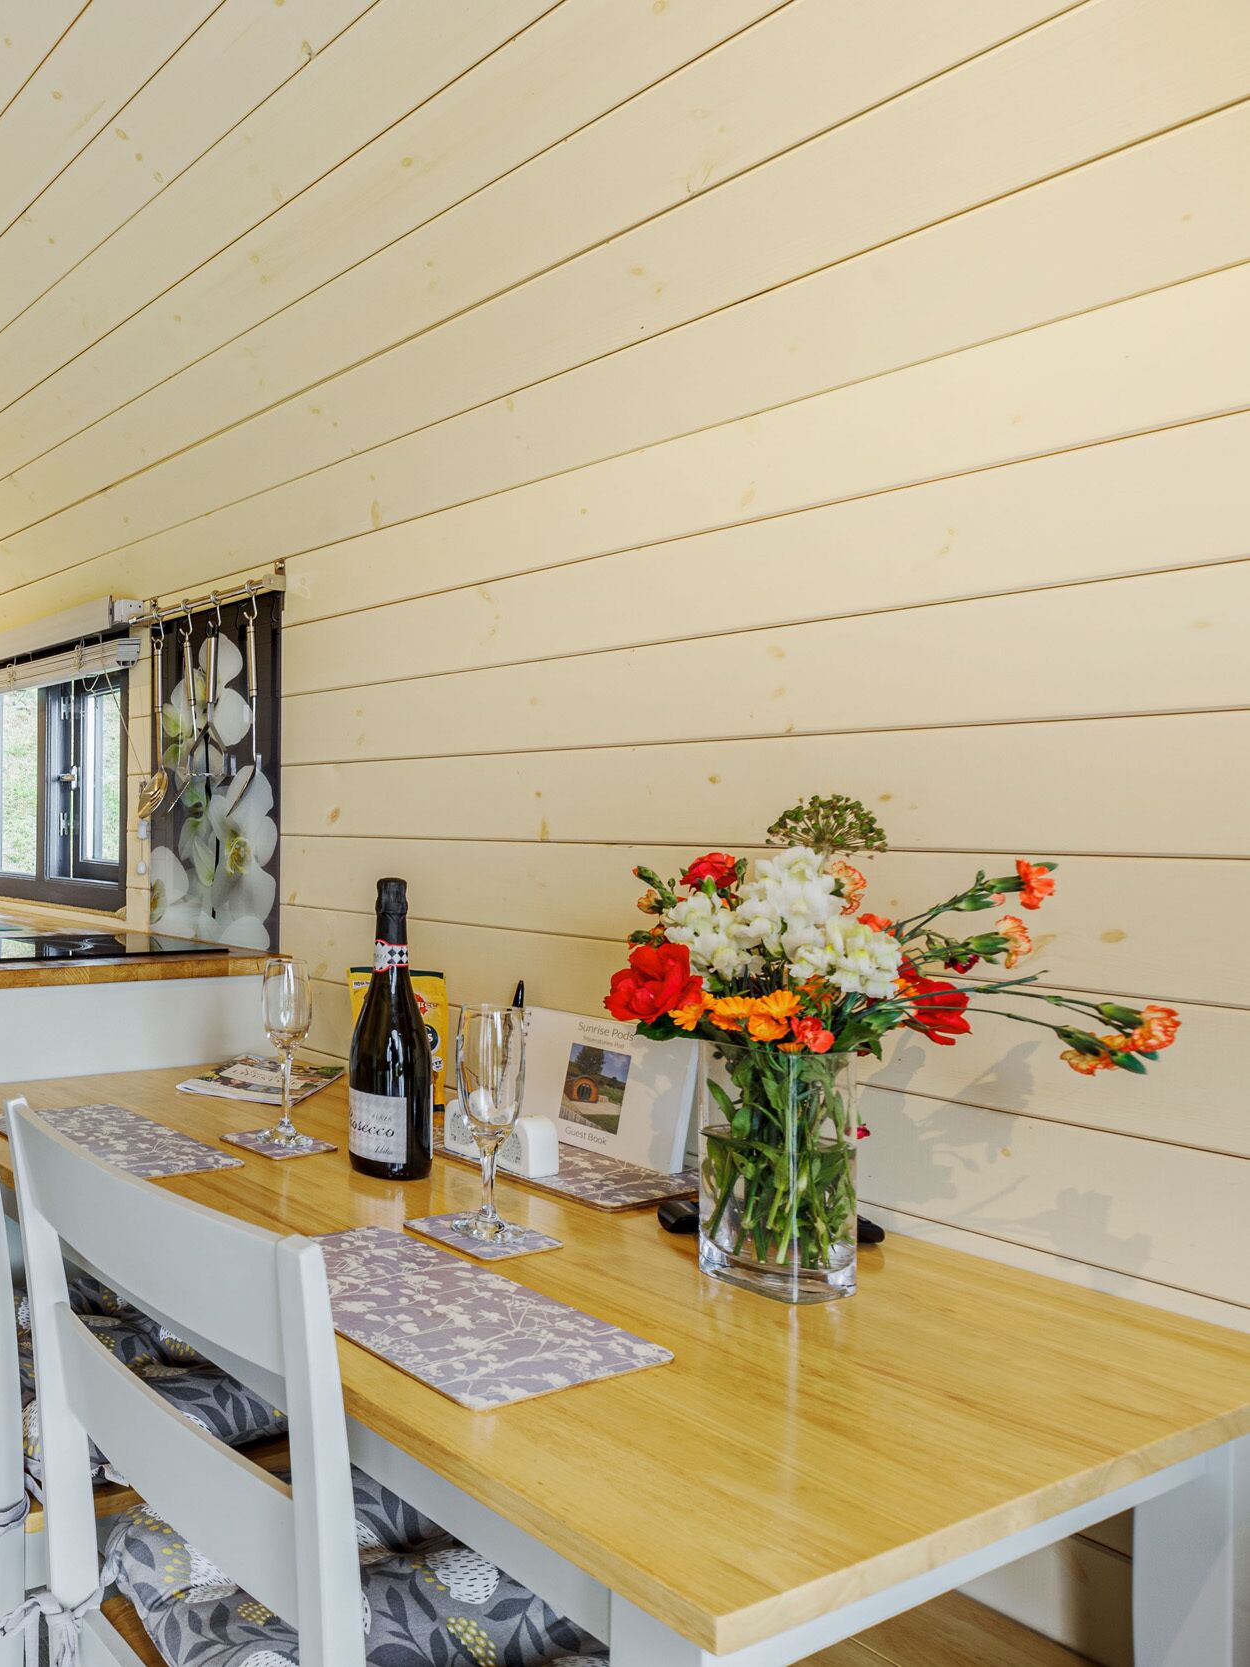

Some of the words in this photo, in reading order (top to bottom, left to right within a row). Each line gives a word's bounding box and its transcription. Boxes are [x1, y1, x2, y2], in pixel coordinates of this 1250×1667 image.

[578, 1021, 609, 1036] Sunrise
[611, 1028, 635, 1042] Pods
[565, 1126, 586, 1140] Guest
[587, 1133, 606, 1146] Book
